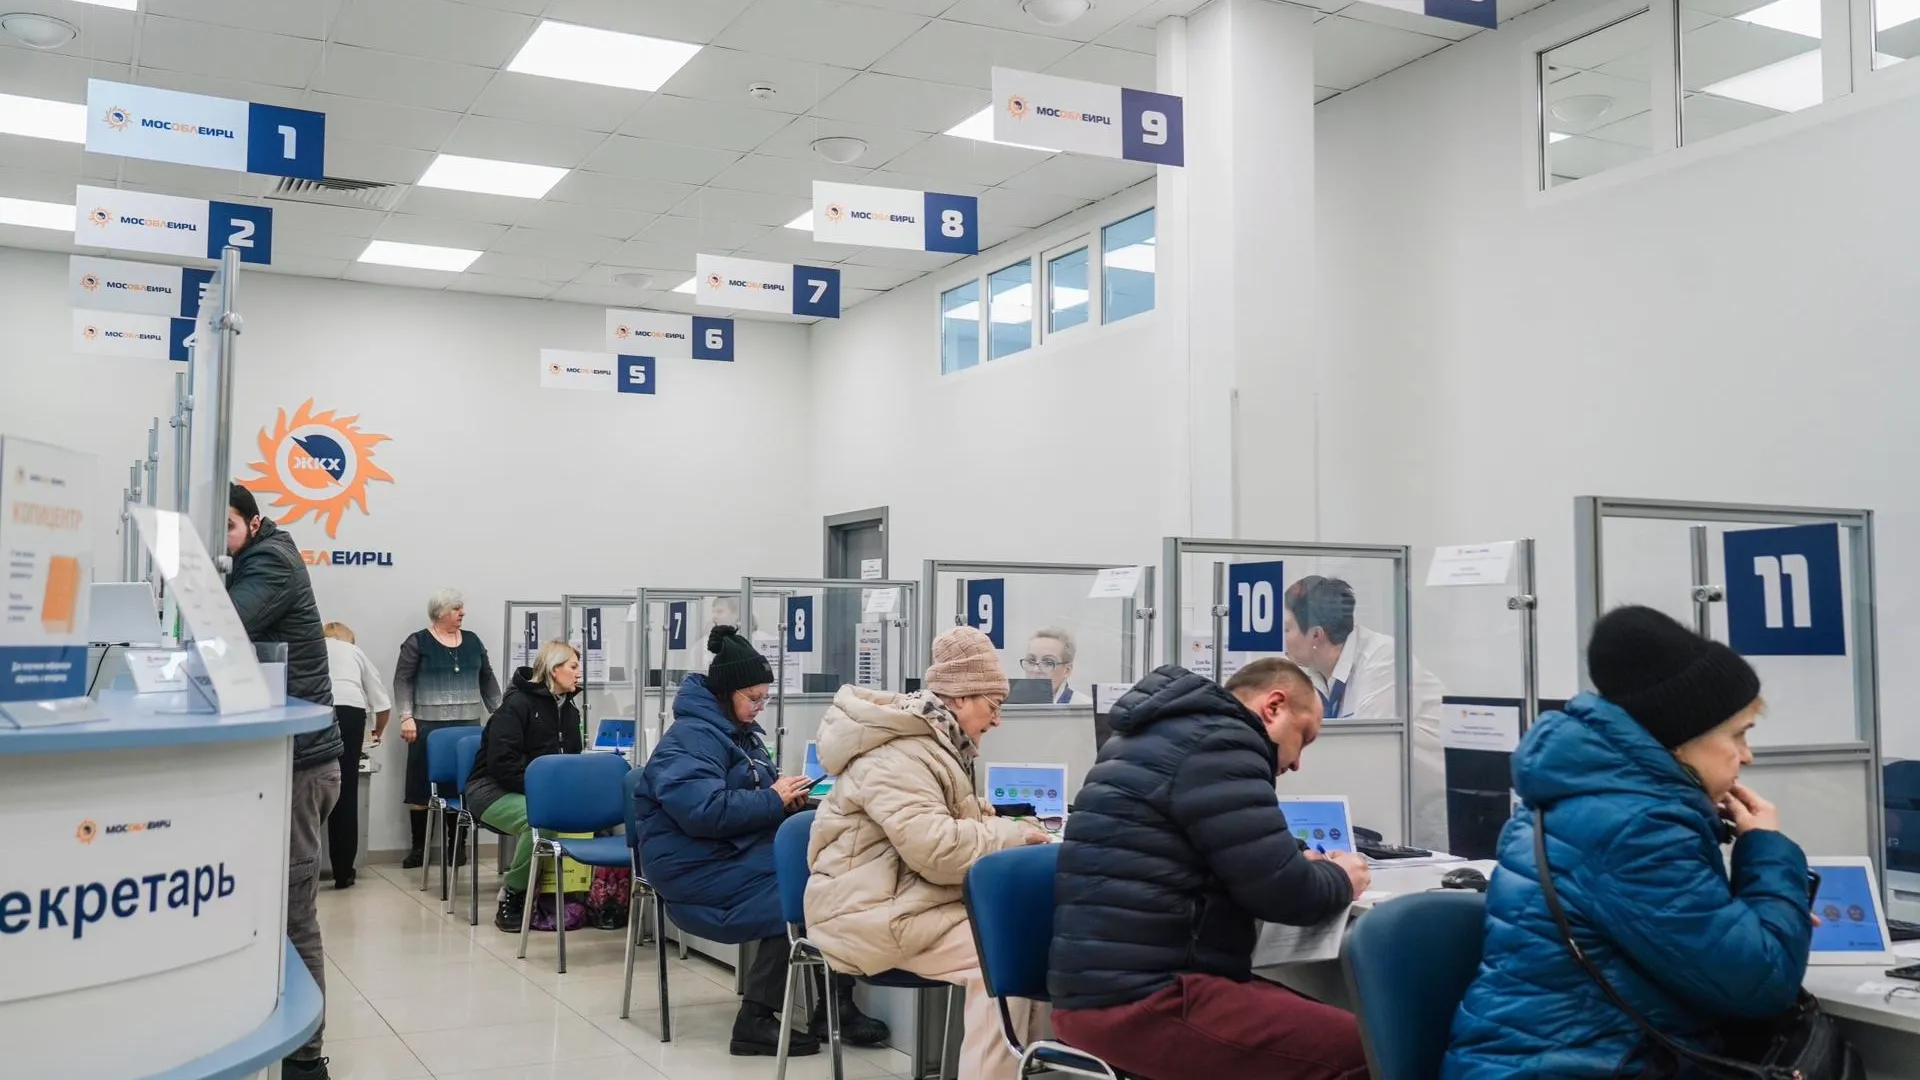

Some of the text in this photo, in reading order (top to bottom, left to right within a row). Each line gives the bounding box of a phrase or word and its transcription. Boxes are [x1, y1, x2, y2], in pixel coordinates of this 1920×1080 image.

[141, 118, 297, 160] МОСОБЛЕИРЦ 1
[1036, 105, 1168, 146] МОСОБЛЕИРЦ 9
[120, 215, 255, 248] МОСОБЛЕИРЦ 2
[850, 209, 965, 238] МОСОБЛЕИРЦ 8
[106, 280, 172, 295] МОСОБЛЕИРЦ
[728, 278, 828, 304] МОСОБЛЕИРЦ 7
[634, 328, 724, 350] МОСОБЛЕИРЦ 6
[628, 364, 646, 385] 5
[293, 455, 342, 472] ЖКХ
[1753, 553, 1812, 629] 11
[978, 593, 993, 635] 9
[1237, 580, 1274, 634] 10
[530, 620, 537, 643] 5
[591, 616, 598, 641] 6
[674, 611, 682, 640] 7
[794, 608, 806, 641] 8
